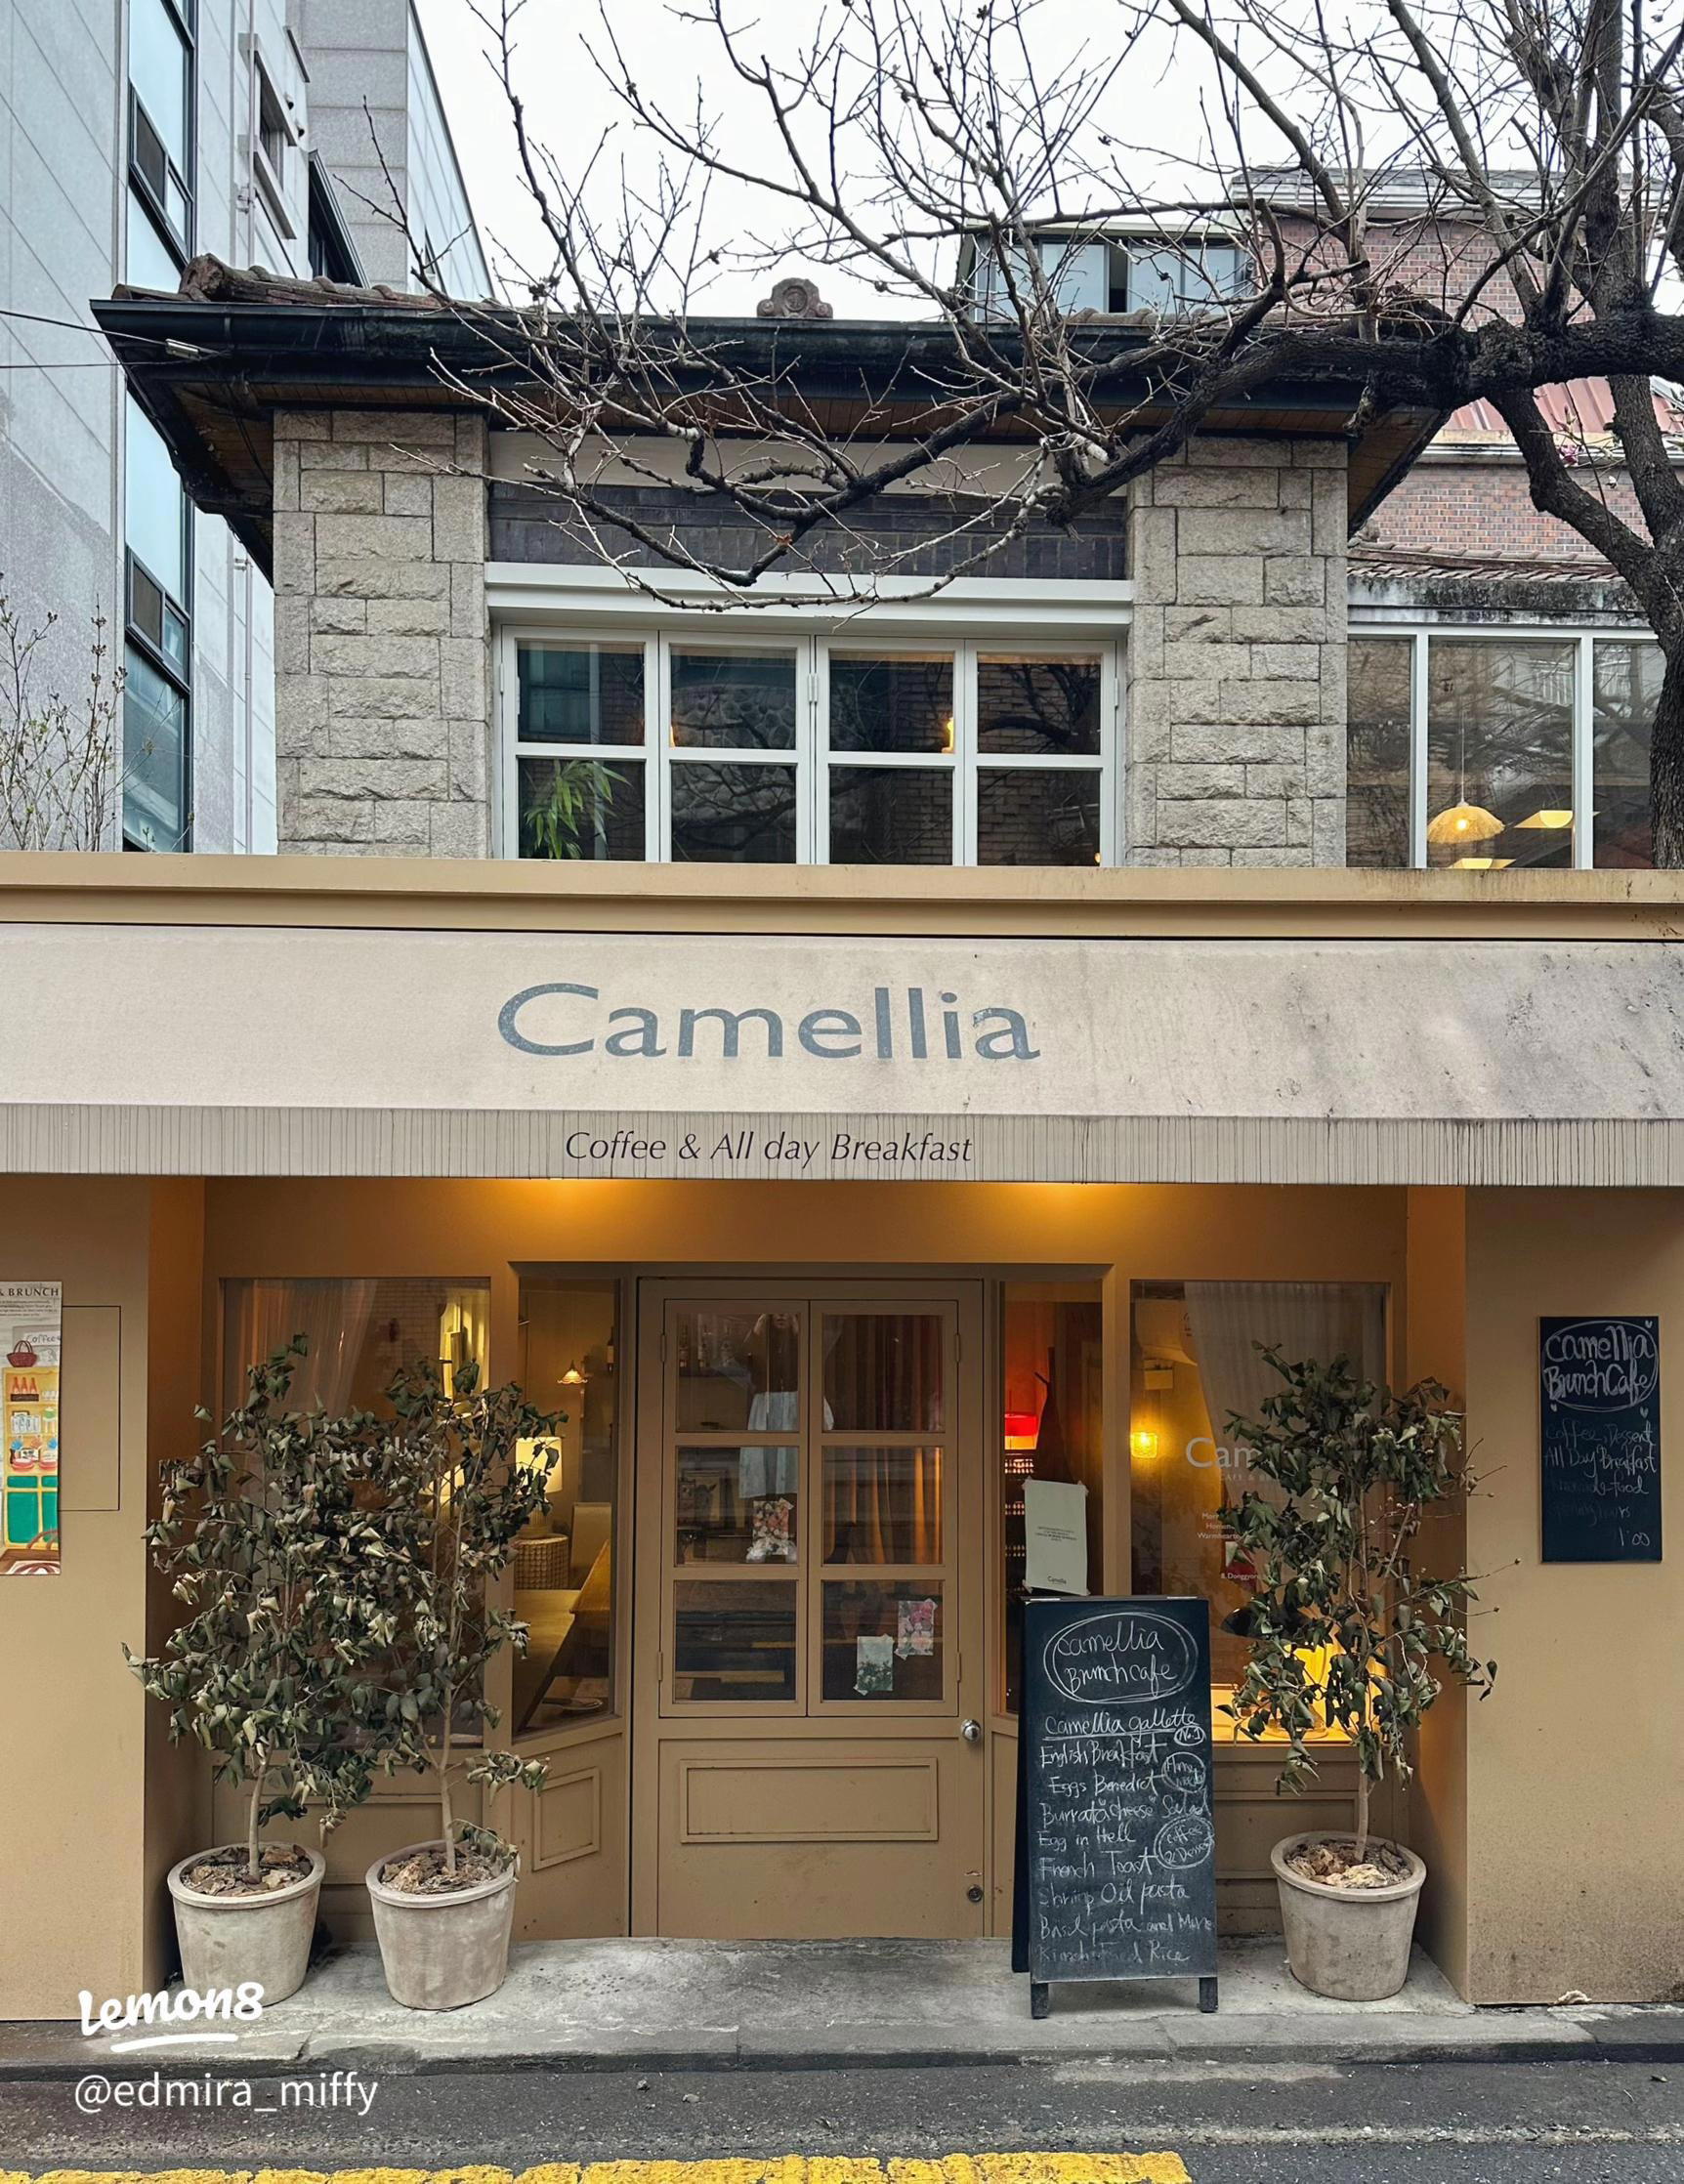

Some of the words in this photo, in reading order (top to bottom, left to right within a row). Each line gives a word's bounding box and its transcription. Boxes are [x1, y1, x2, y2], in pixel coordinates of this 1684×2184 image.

[497, 983, 1041, 1060] Camellia
[566, 1130, 666, 1160] Coffee
[679, 1133, 700, 1160] &
[710, 1131, 753, 1160] All
[764, 1132, 821, 1168] day
[831, 1133, 973, 1162] Breakfast
[8, 1287, 59, 1297] BRUNCH
[1039, 1740, 1088, 1769] English
[1086, 1733, 1167, 1769] Breakfast
[1048, 1776, 1087, 1798] Eggs
[1037, 1830, 1067, 1852] Egg
[1075, 1837, 1089, 1846] in
[1096, 1822, 1136, 1844] Hell
[1038, 1852, 1095, 1881] French
[1101, 1846, 1158, 1876] Toast
[1101, 1878, 1134, 1904] Oil
[1147, 1913, 1174, 1932] and
[1150, 1940, 1192, 1963] Rice
